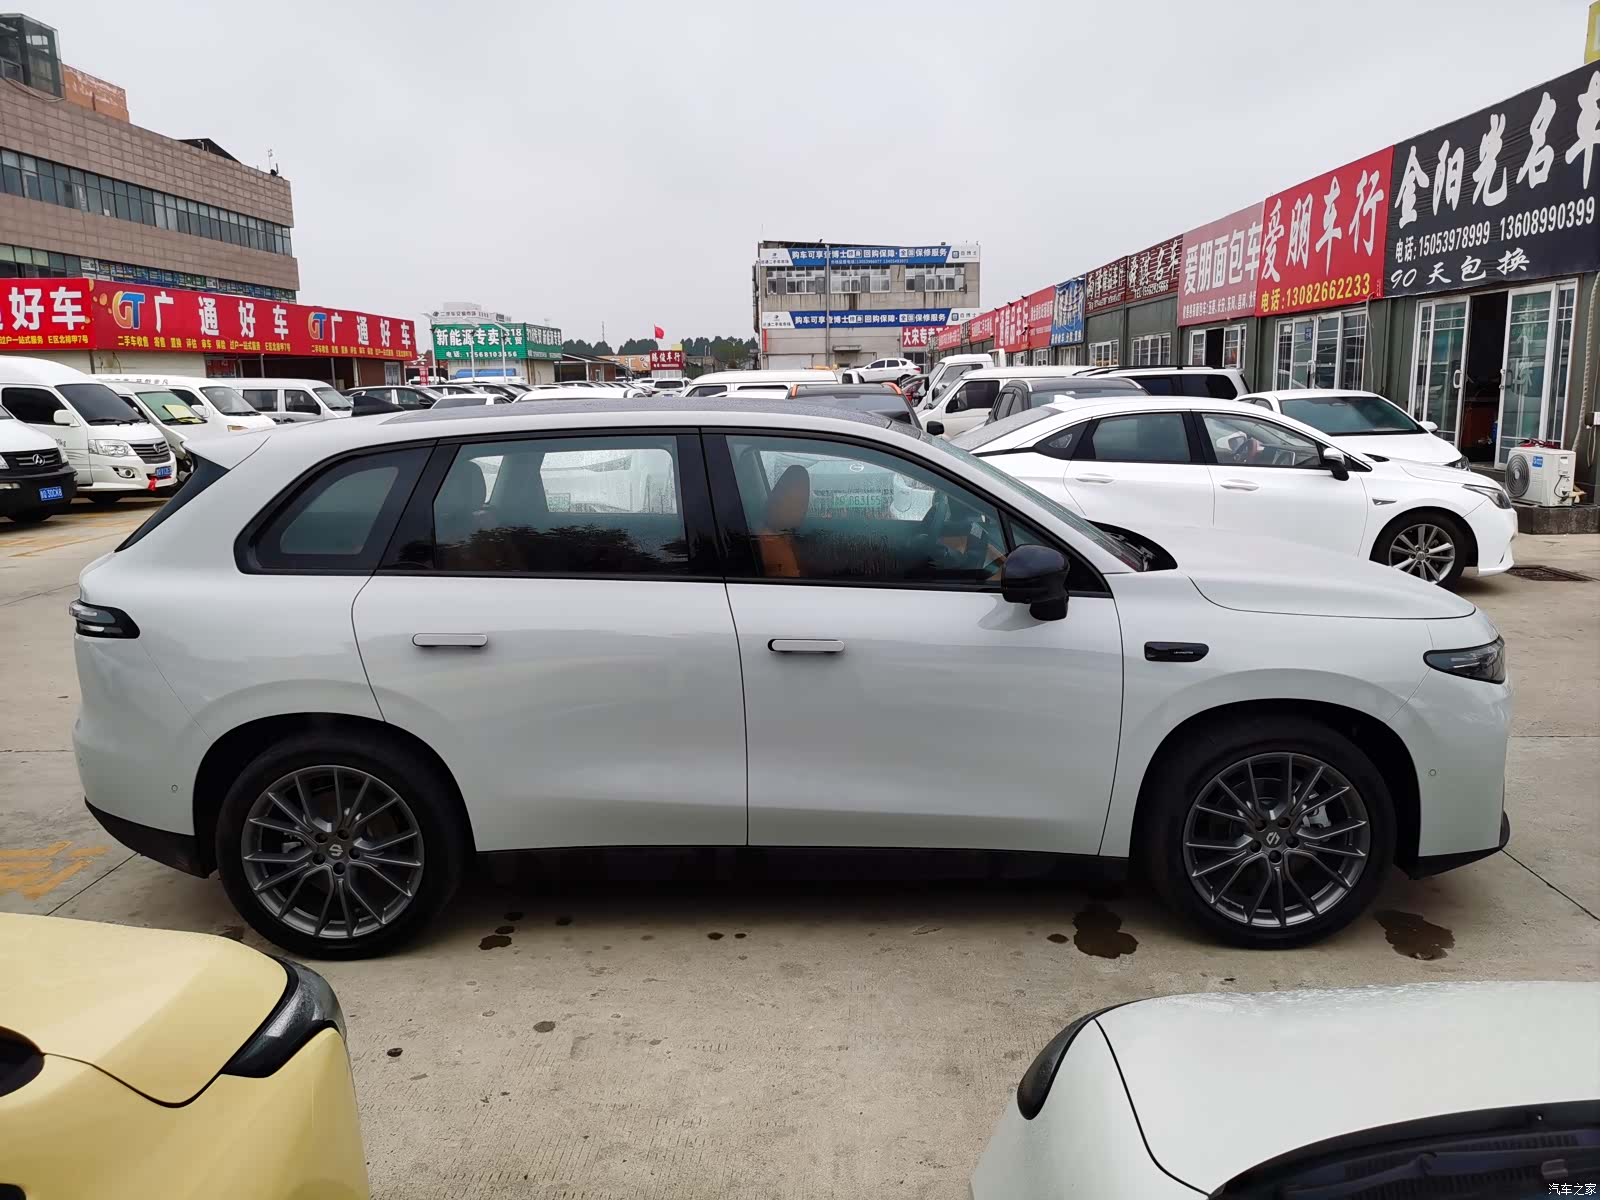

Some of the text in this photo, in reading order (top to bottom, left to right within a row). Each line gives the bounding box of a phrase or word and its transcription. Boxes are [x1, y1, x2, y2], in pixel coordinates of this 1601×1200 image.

[1261, 169, 1384, 282] 爱朋车行
[1499, 196, 1595, 241] 13608990399
[1184, 221, 1263, 296] 爱朋面包车
[0, 286, 86, 331] 好车
[153, 290, 289, 340] 广通好车
[330, 312, 411, 350] 广通好车
[436, 328, 500, 347] 新能源专卖
